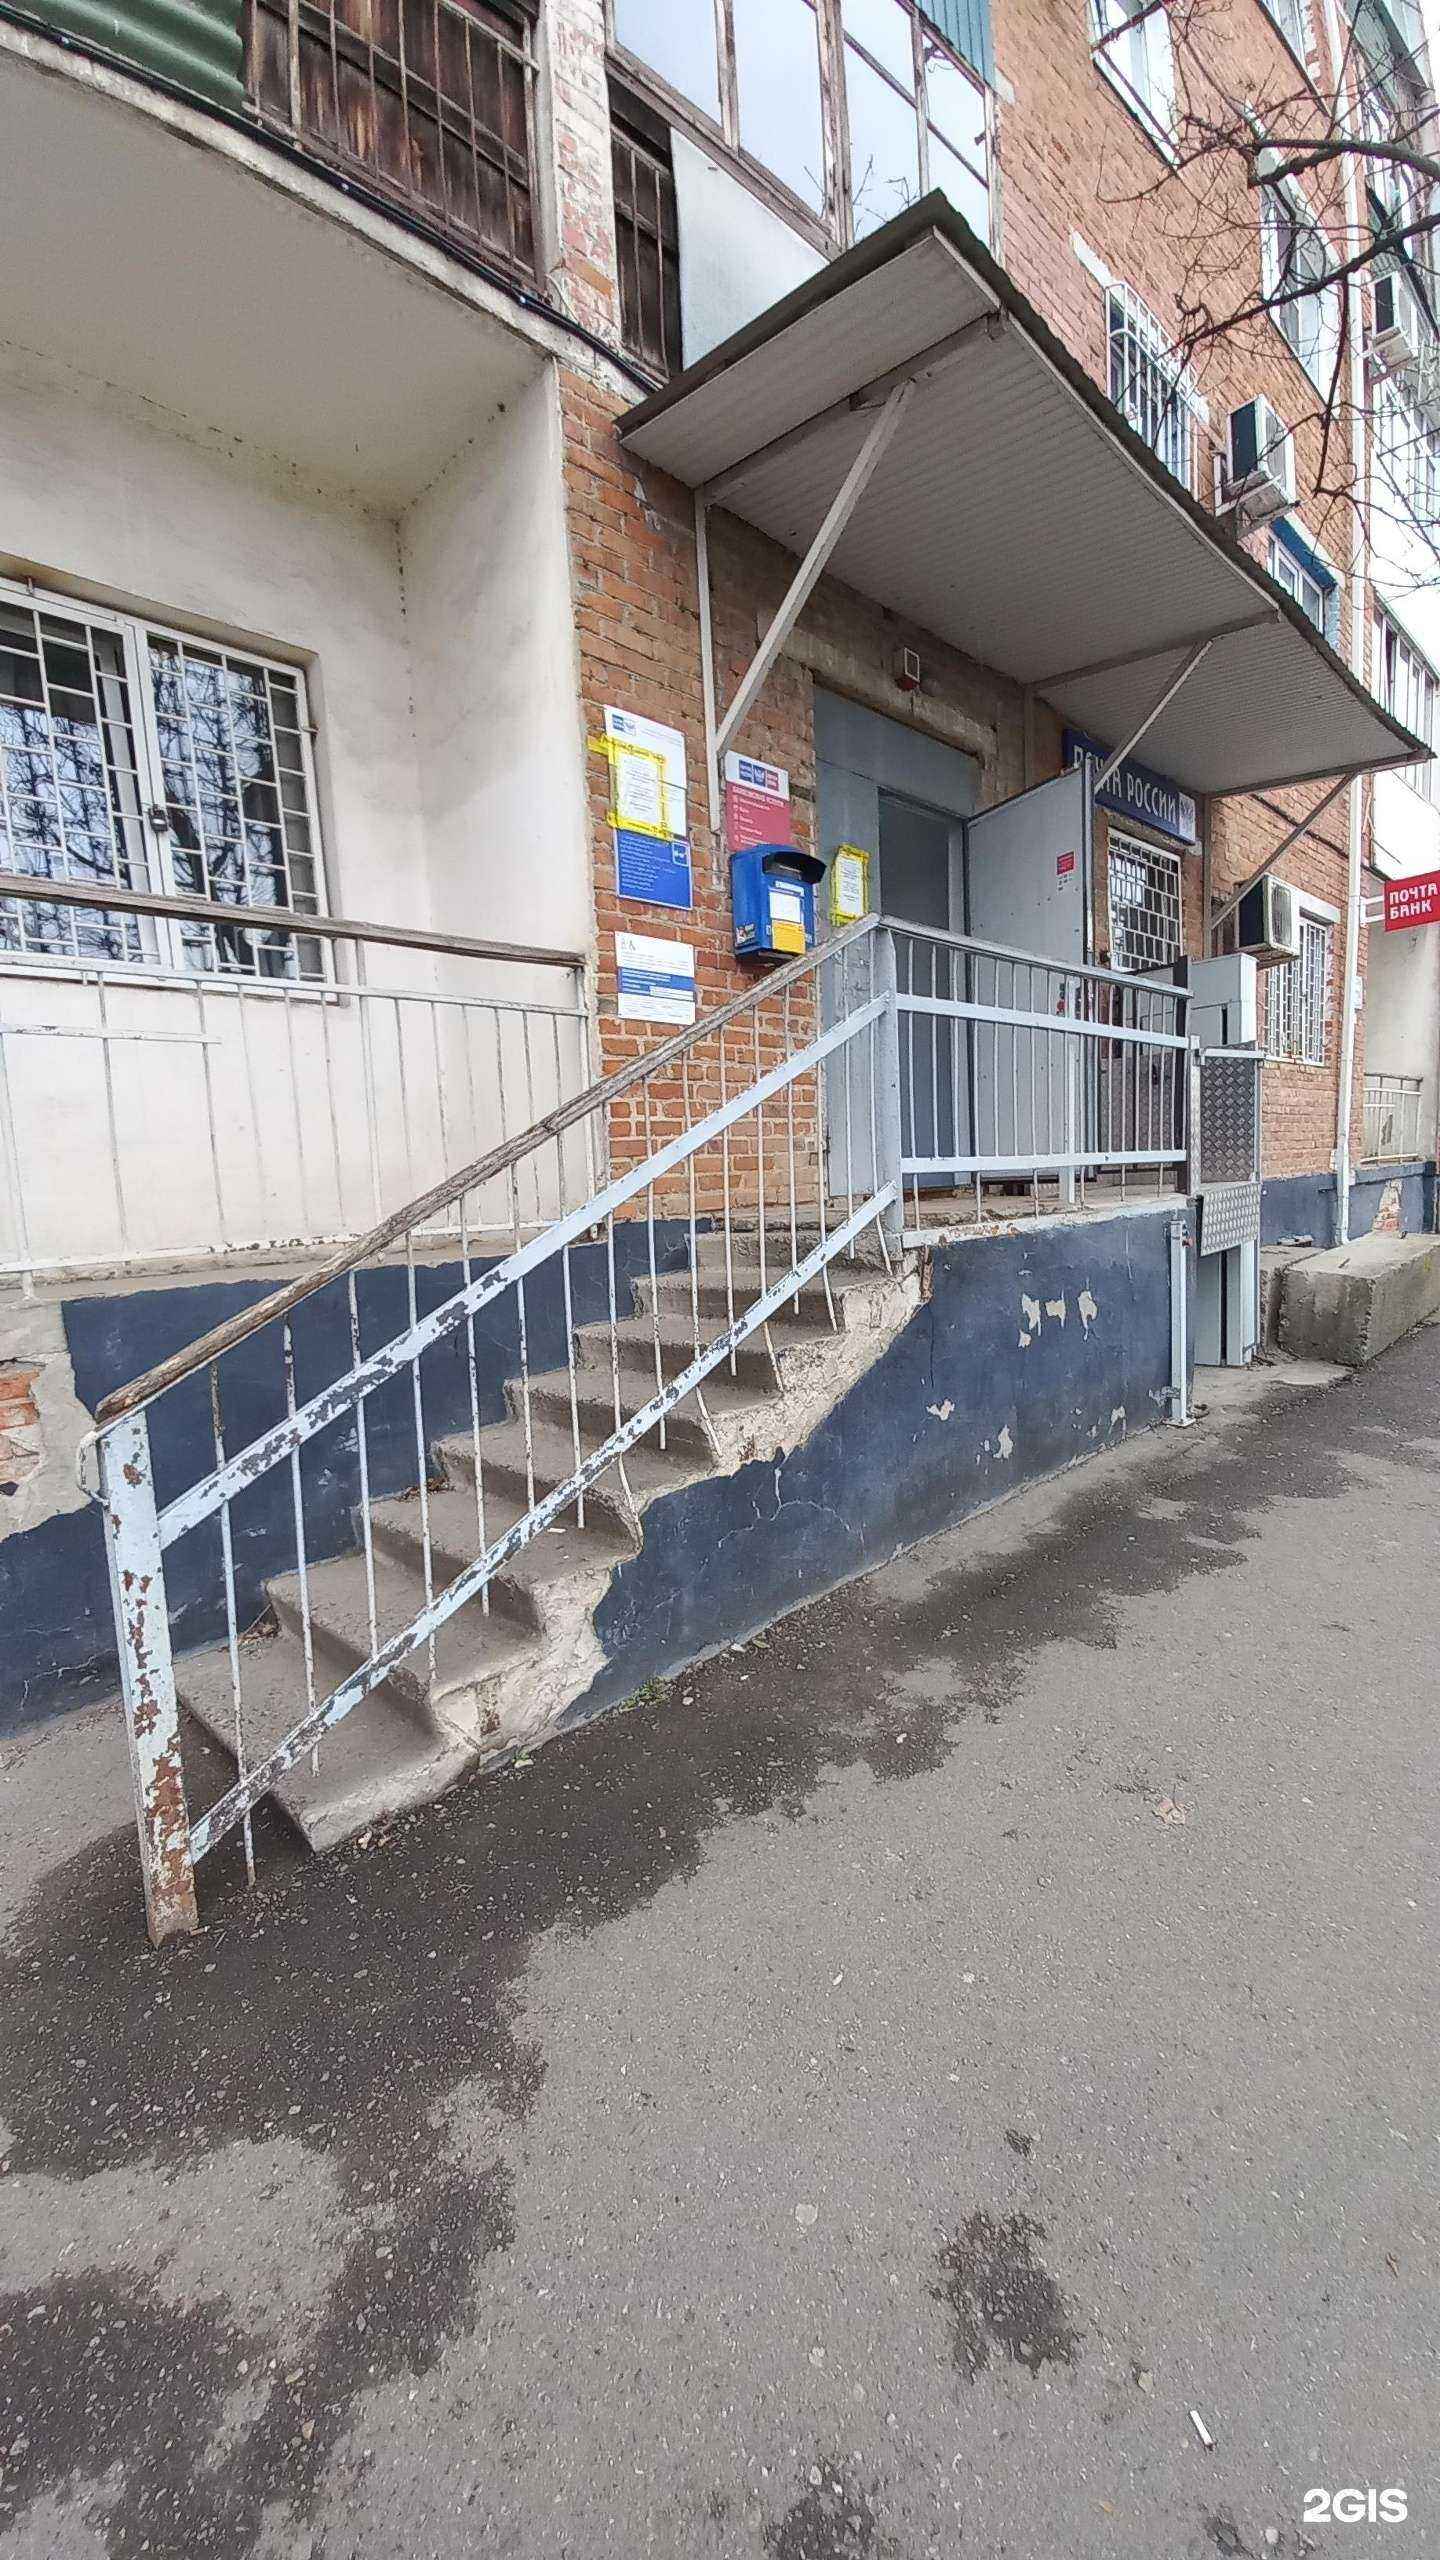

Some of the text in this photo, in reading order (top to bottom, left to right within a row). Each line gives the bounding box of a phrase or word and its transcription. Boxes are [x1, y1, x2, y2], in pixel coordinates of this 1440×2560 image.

[1126, 772, 1177, 827] РОССИИ
[1389, 883, 1438, 905] ПОЧТА
[1390, 899, 1432, 919] БАНК
